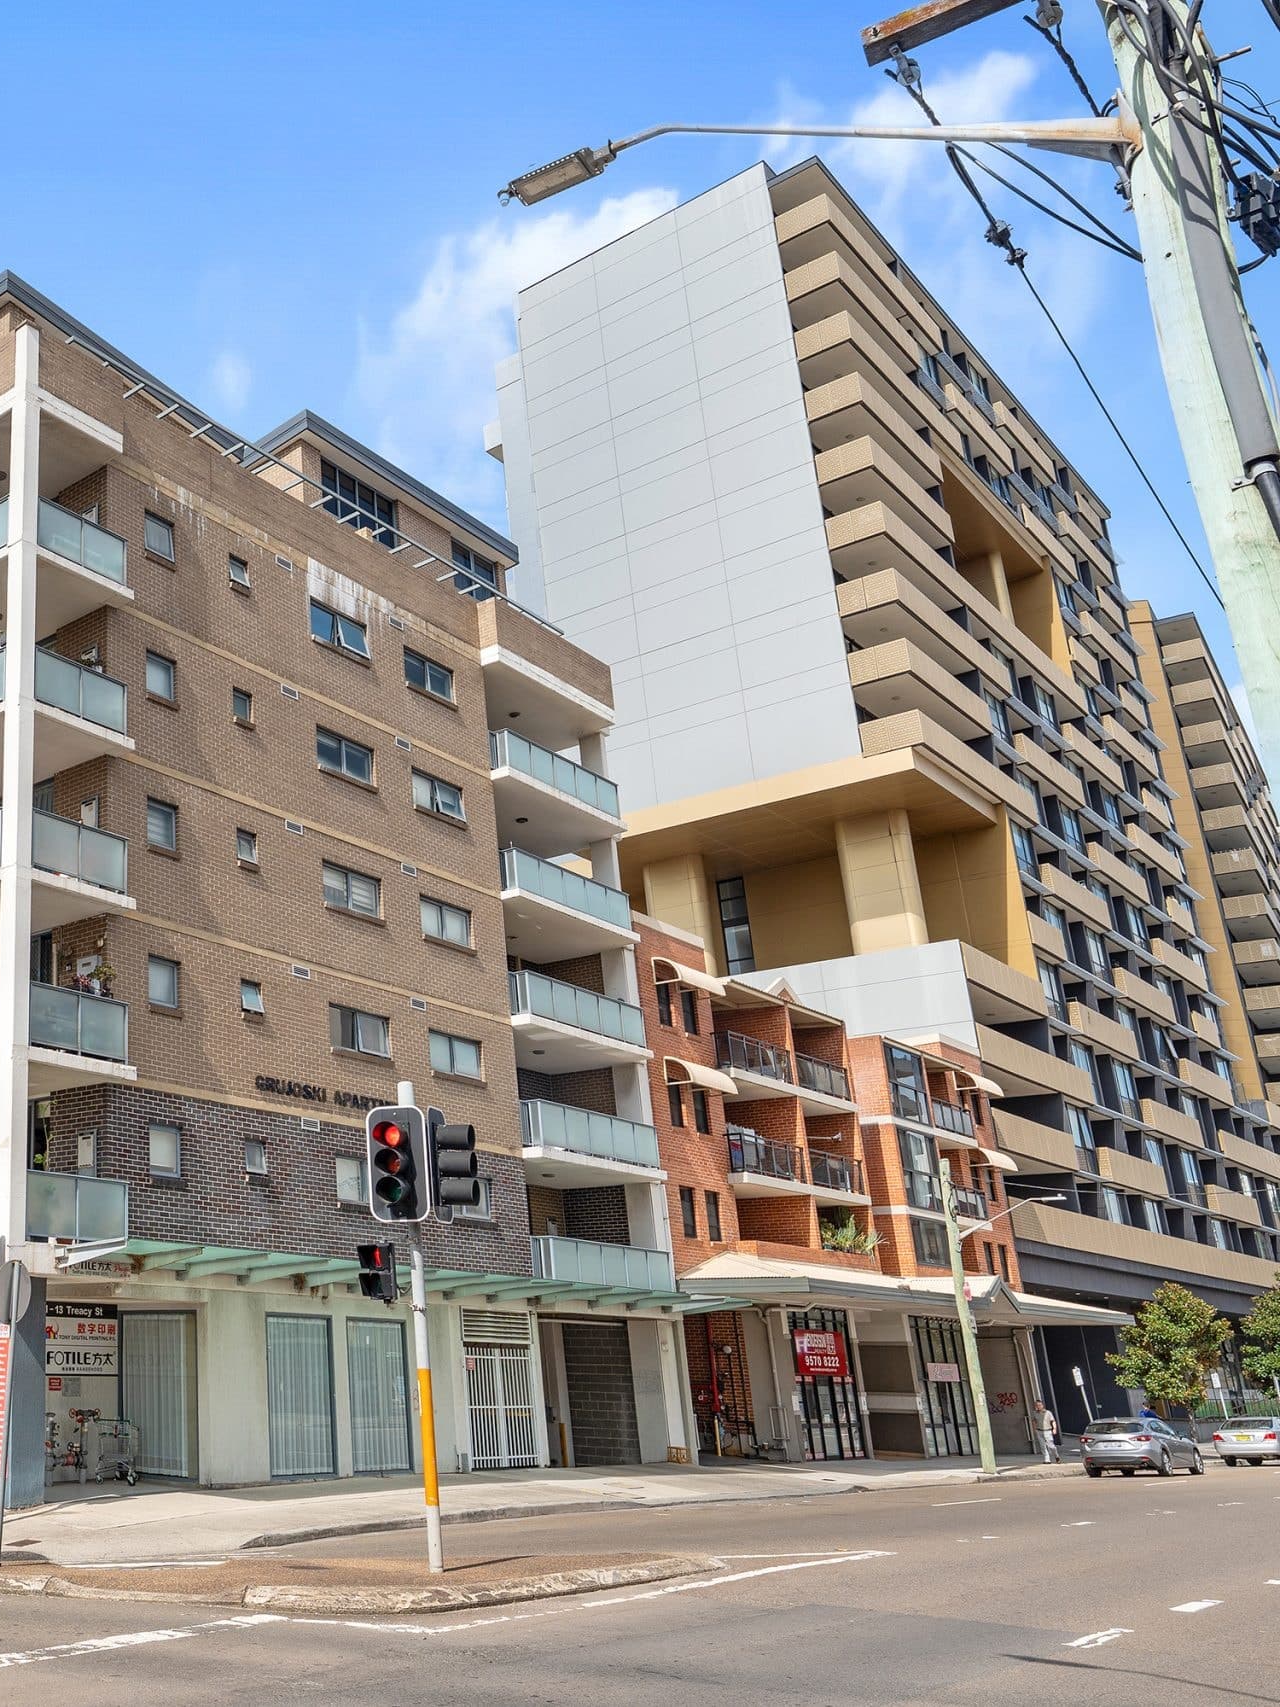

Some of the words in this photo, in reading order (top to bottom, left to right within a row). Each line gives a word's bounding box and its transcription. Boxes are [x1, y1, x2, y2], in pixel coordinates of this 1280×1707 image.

[66, 1305, 93, 1318] Treacy
[94, 1306, 103, 1317] St
[46, 1351, 91, 1366] FOTILE
[804, 1355, 822, 1367] 9570
[822, 1355, 840, 1368] 8222
